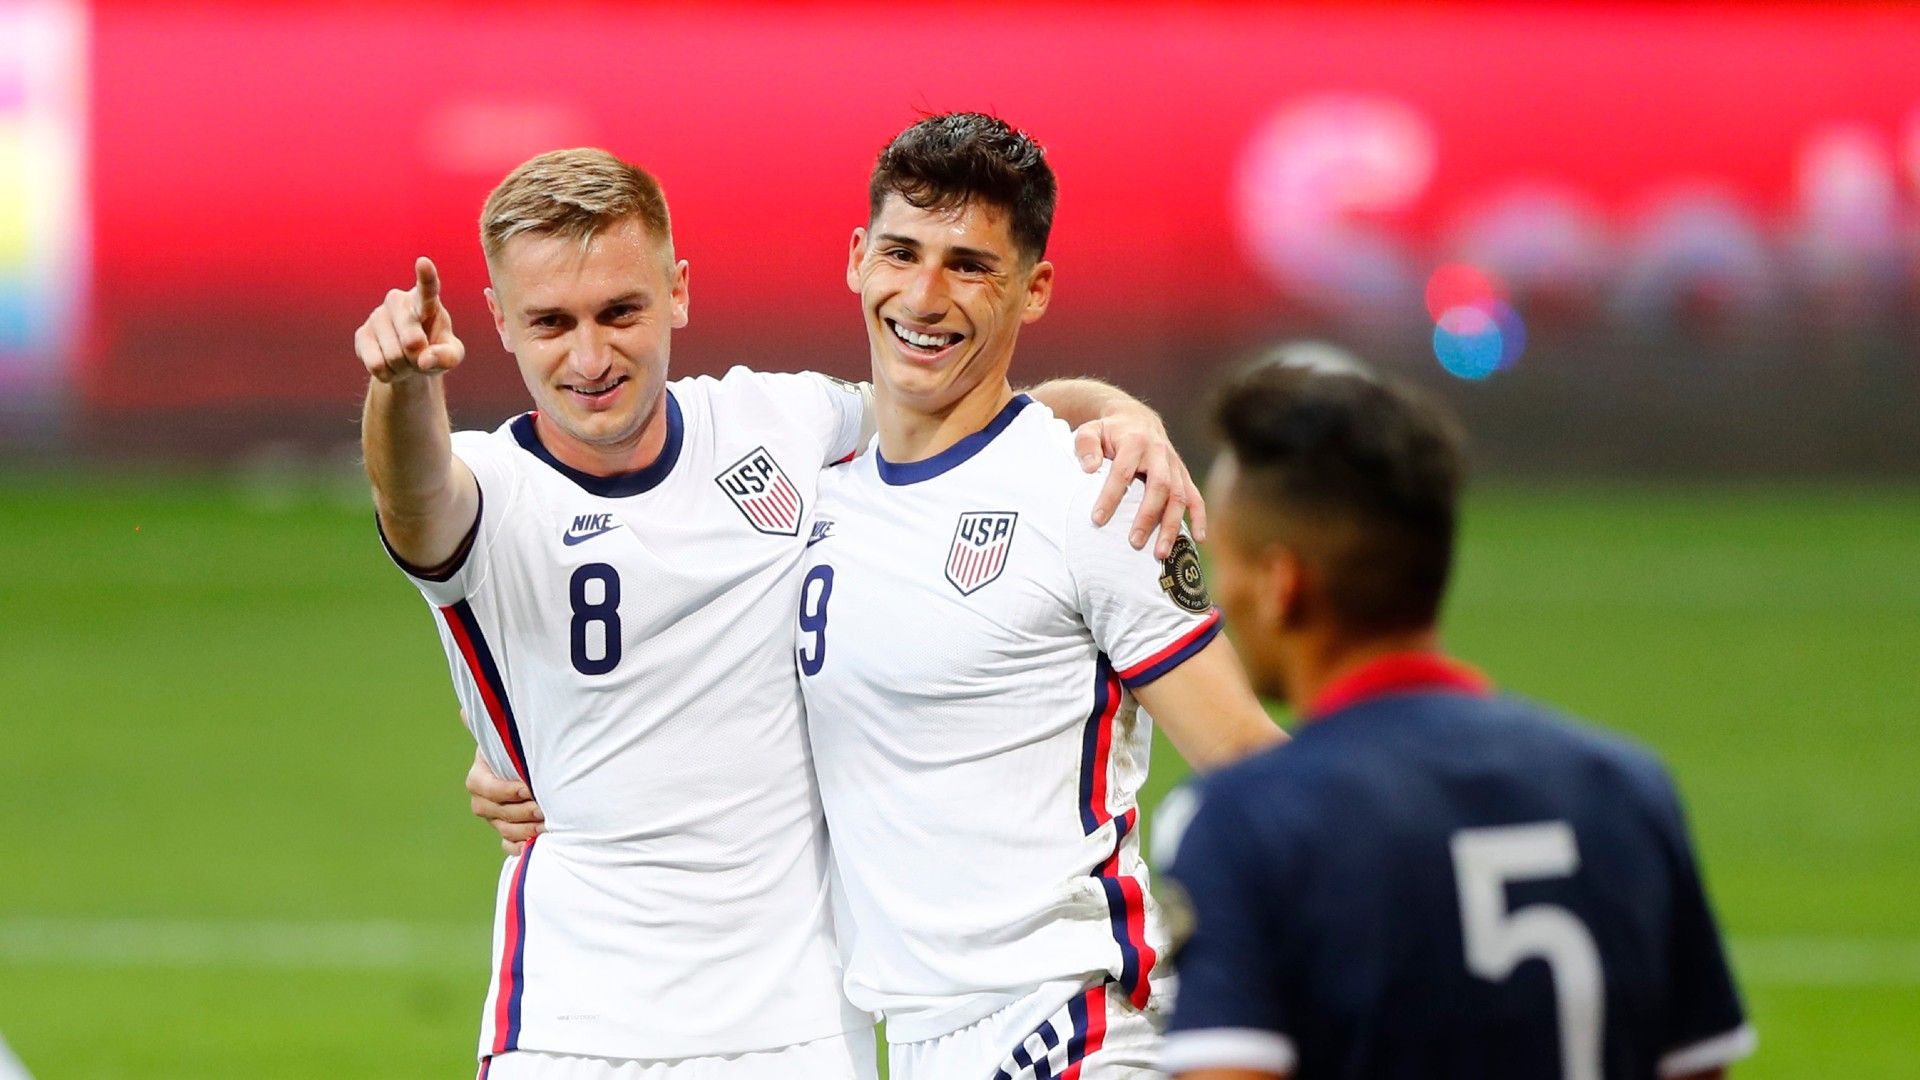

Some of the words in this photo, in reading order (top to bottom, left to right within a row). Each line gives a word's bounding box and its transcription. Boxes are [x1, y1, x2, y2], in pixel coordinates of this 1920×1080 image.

[724, 454, 774, 496] USA
[571, 513, 613, 531] NIKE
[960, 518, 1010, 547] USA
[1184, 565, 1199, 582] 60
[569, 562, 622, 676] 8
[799, 564, 834, 677] 9
[1450, 820, 1607, 1080] 5
